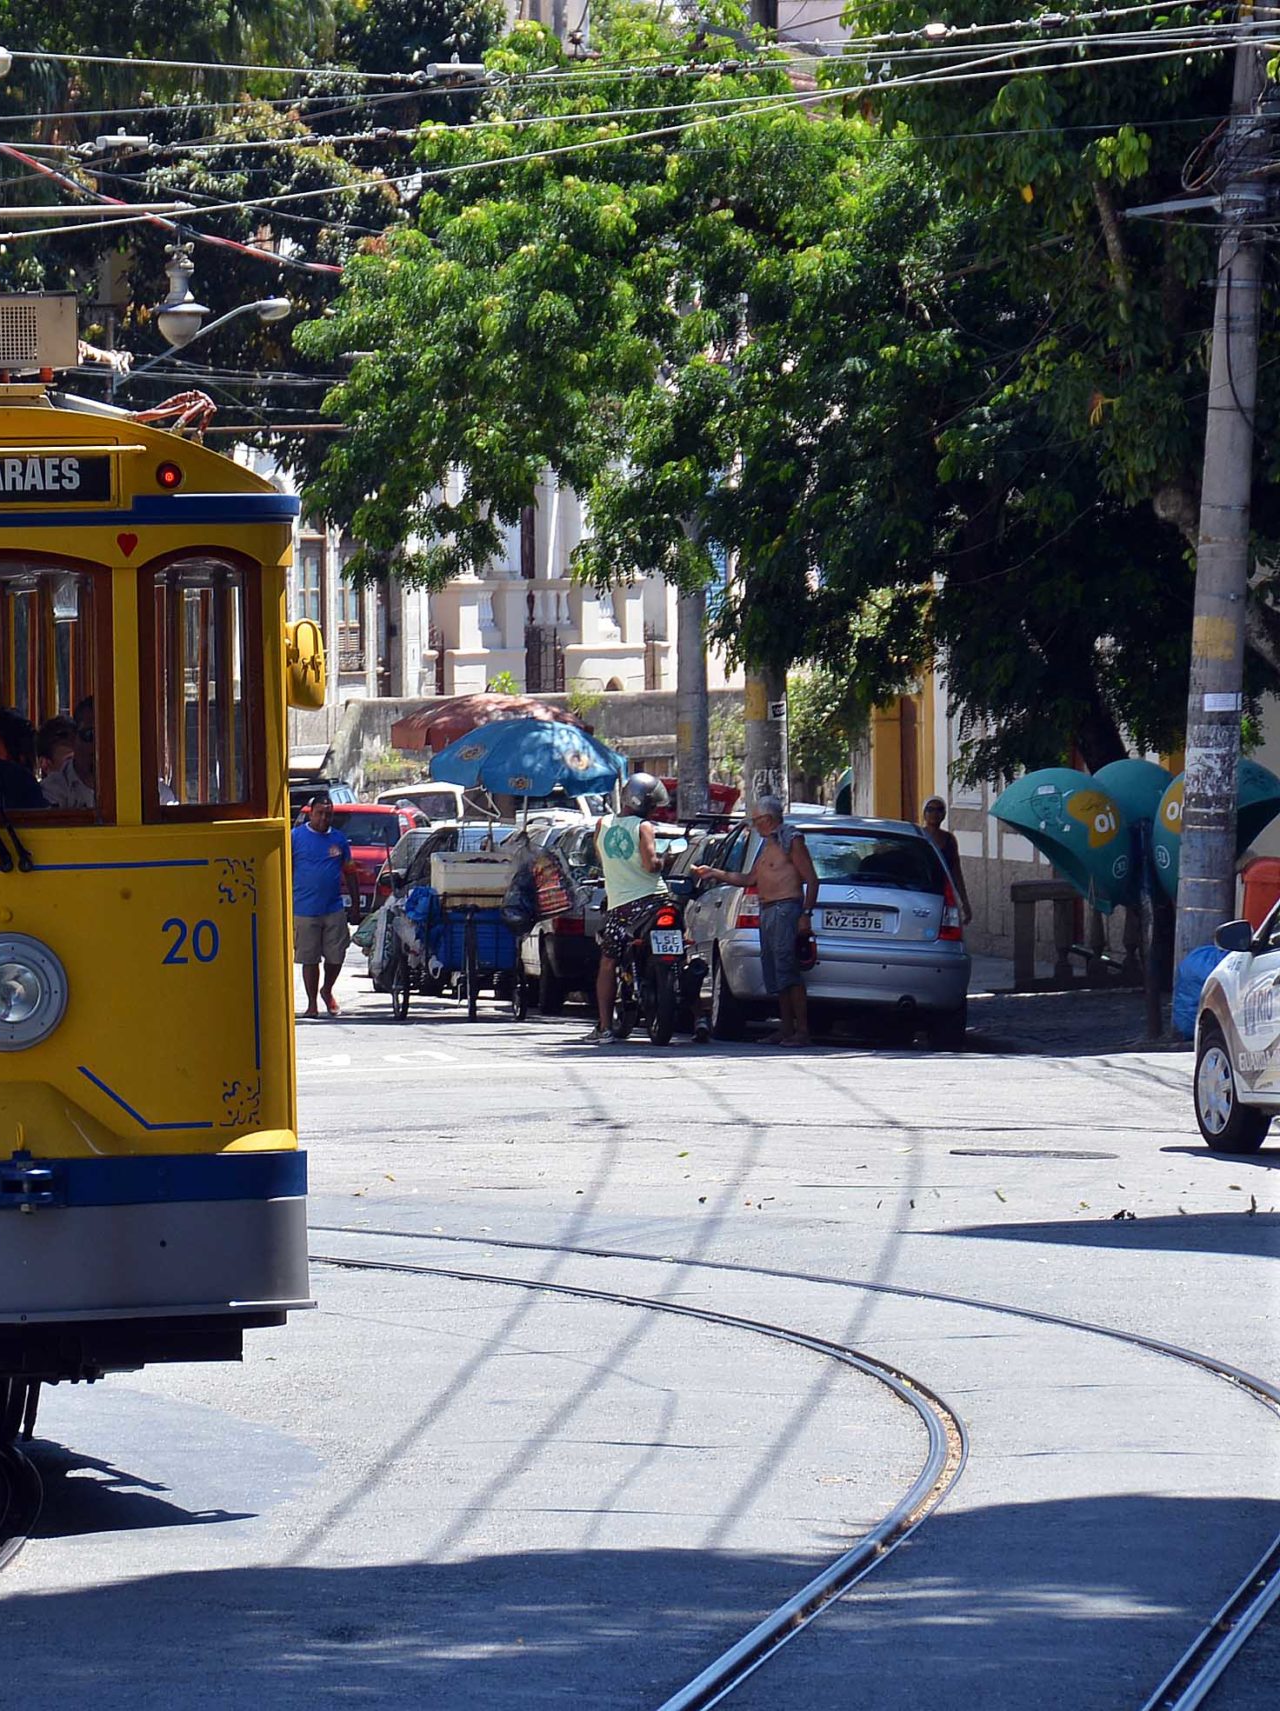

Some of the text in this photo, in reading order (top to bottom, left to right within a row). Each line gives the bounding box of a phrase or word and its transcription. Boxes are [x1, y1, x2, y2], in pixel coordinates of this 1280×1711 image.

[1094, 805, 1116, 833] oi
[161, 917, 220, 965] 20
[1256, 990, 1274, 1022] RIO
